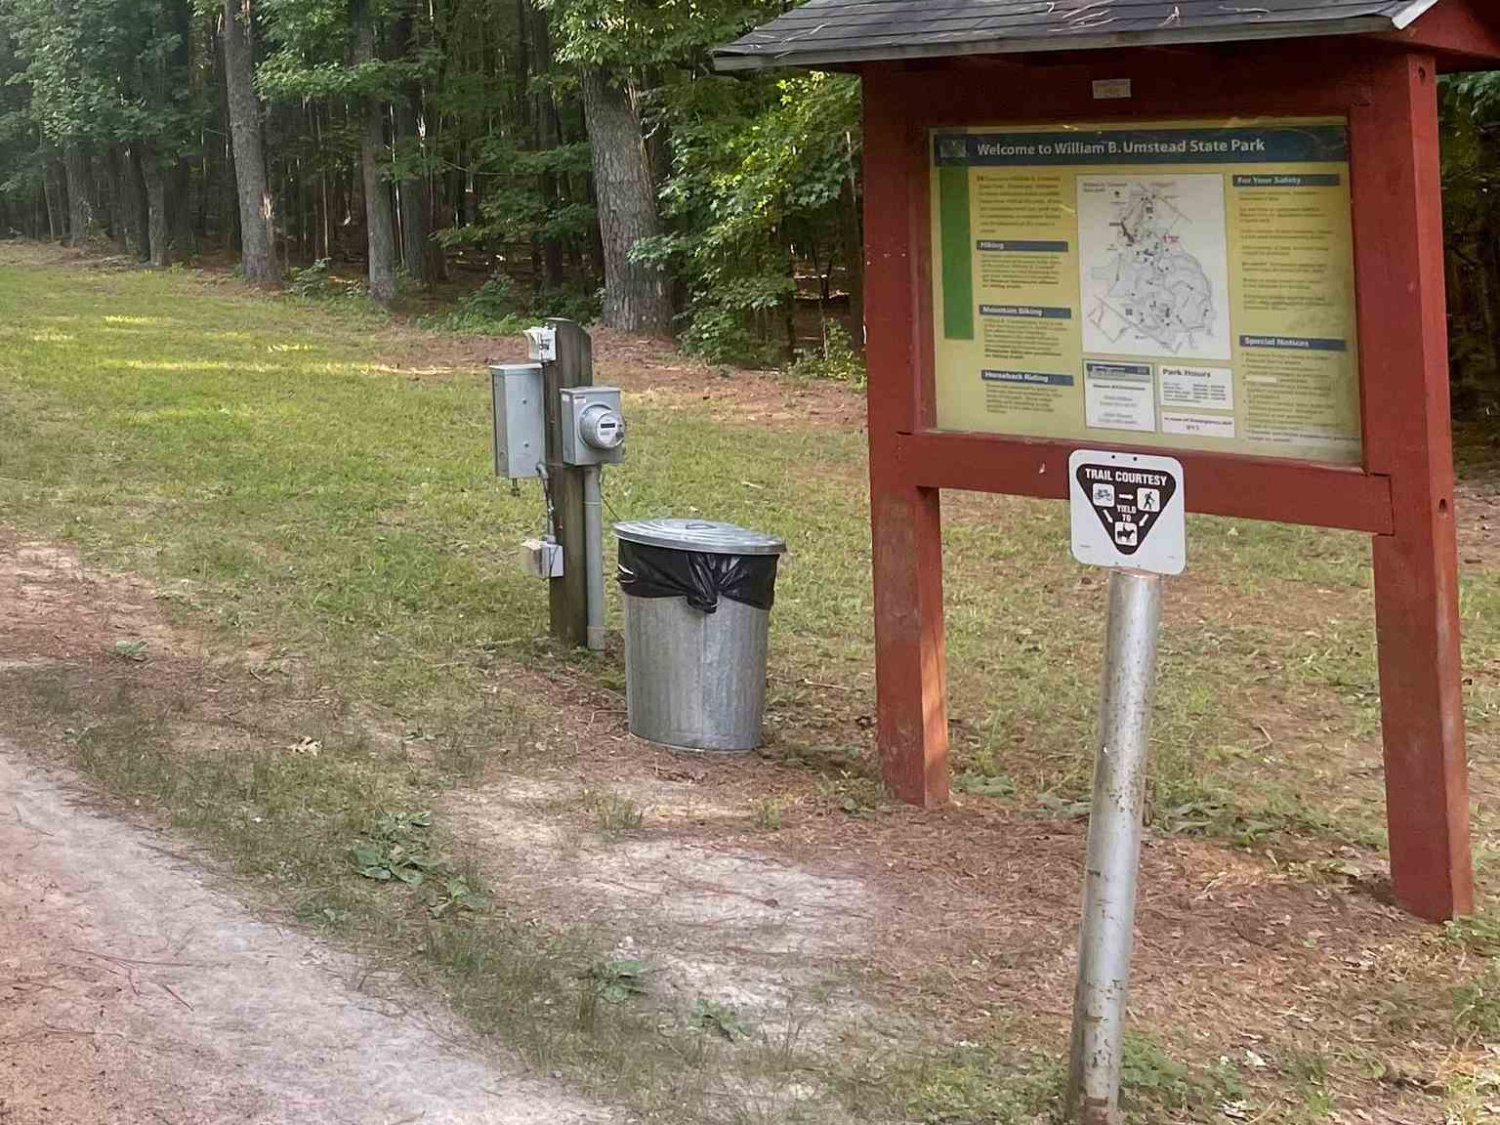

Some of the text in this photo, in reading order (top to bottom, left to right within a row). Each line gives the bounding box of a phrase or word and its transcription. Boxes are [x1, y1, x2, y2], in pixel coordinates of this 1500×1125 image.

[977, 138, 1266, 156] Welcome to William B. Umstead State Park
[1085, 468, 1168, 486] TRAIL COURTESY
[1116, 504, 1137, 514] YIELD
[1122, 514, 1132, 523] TO
